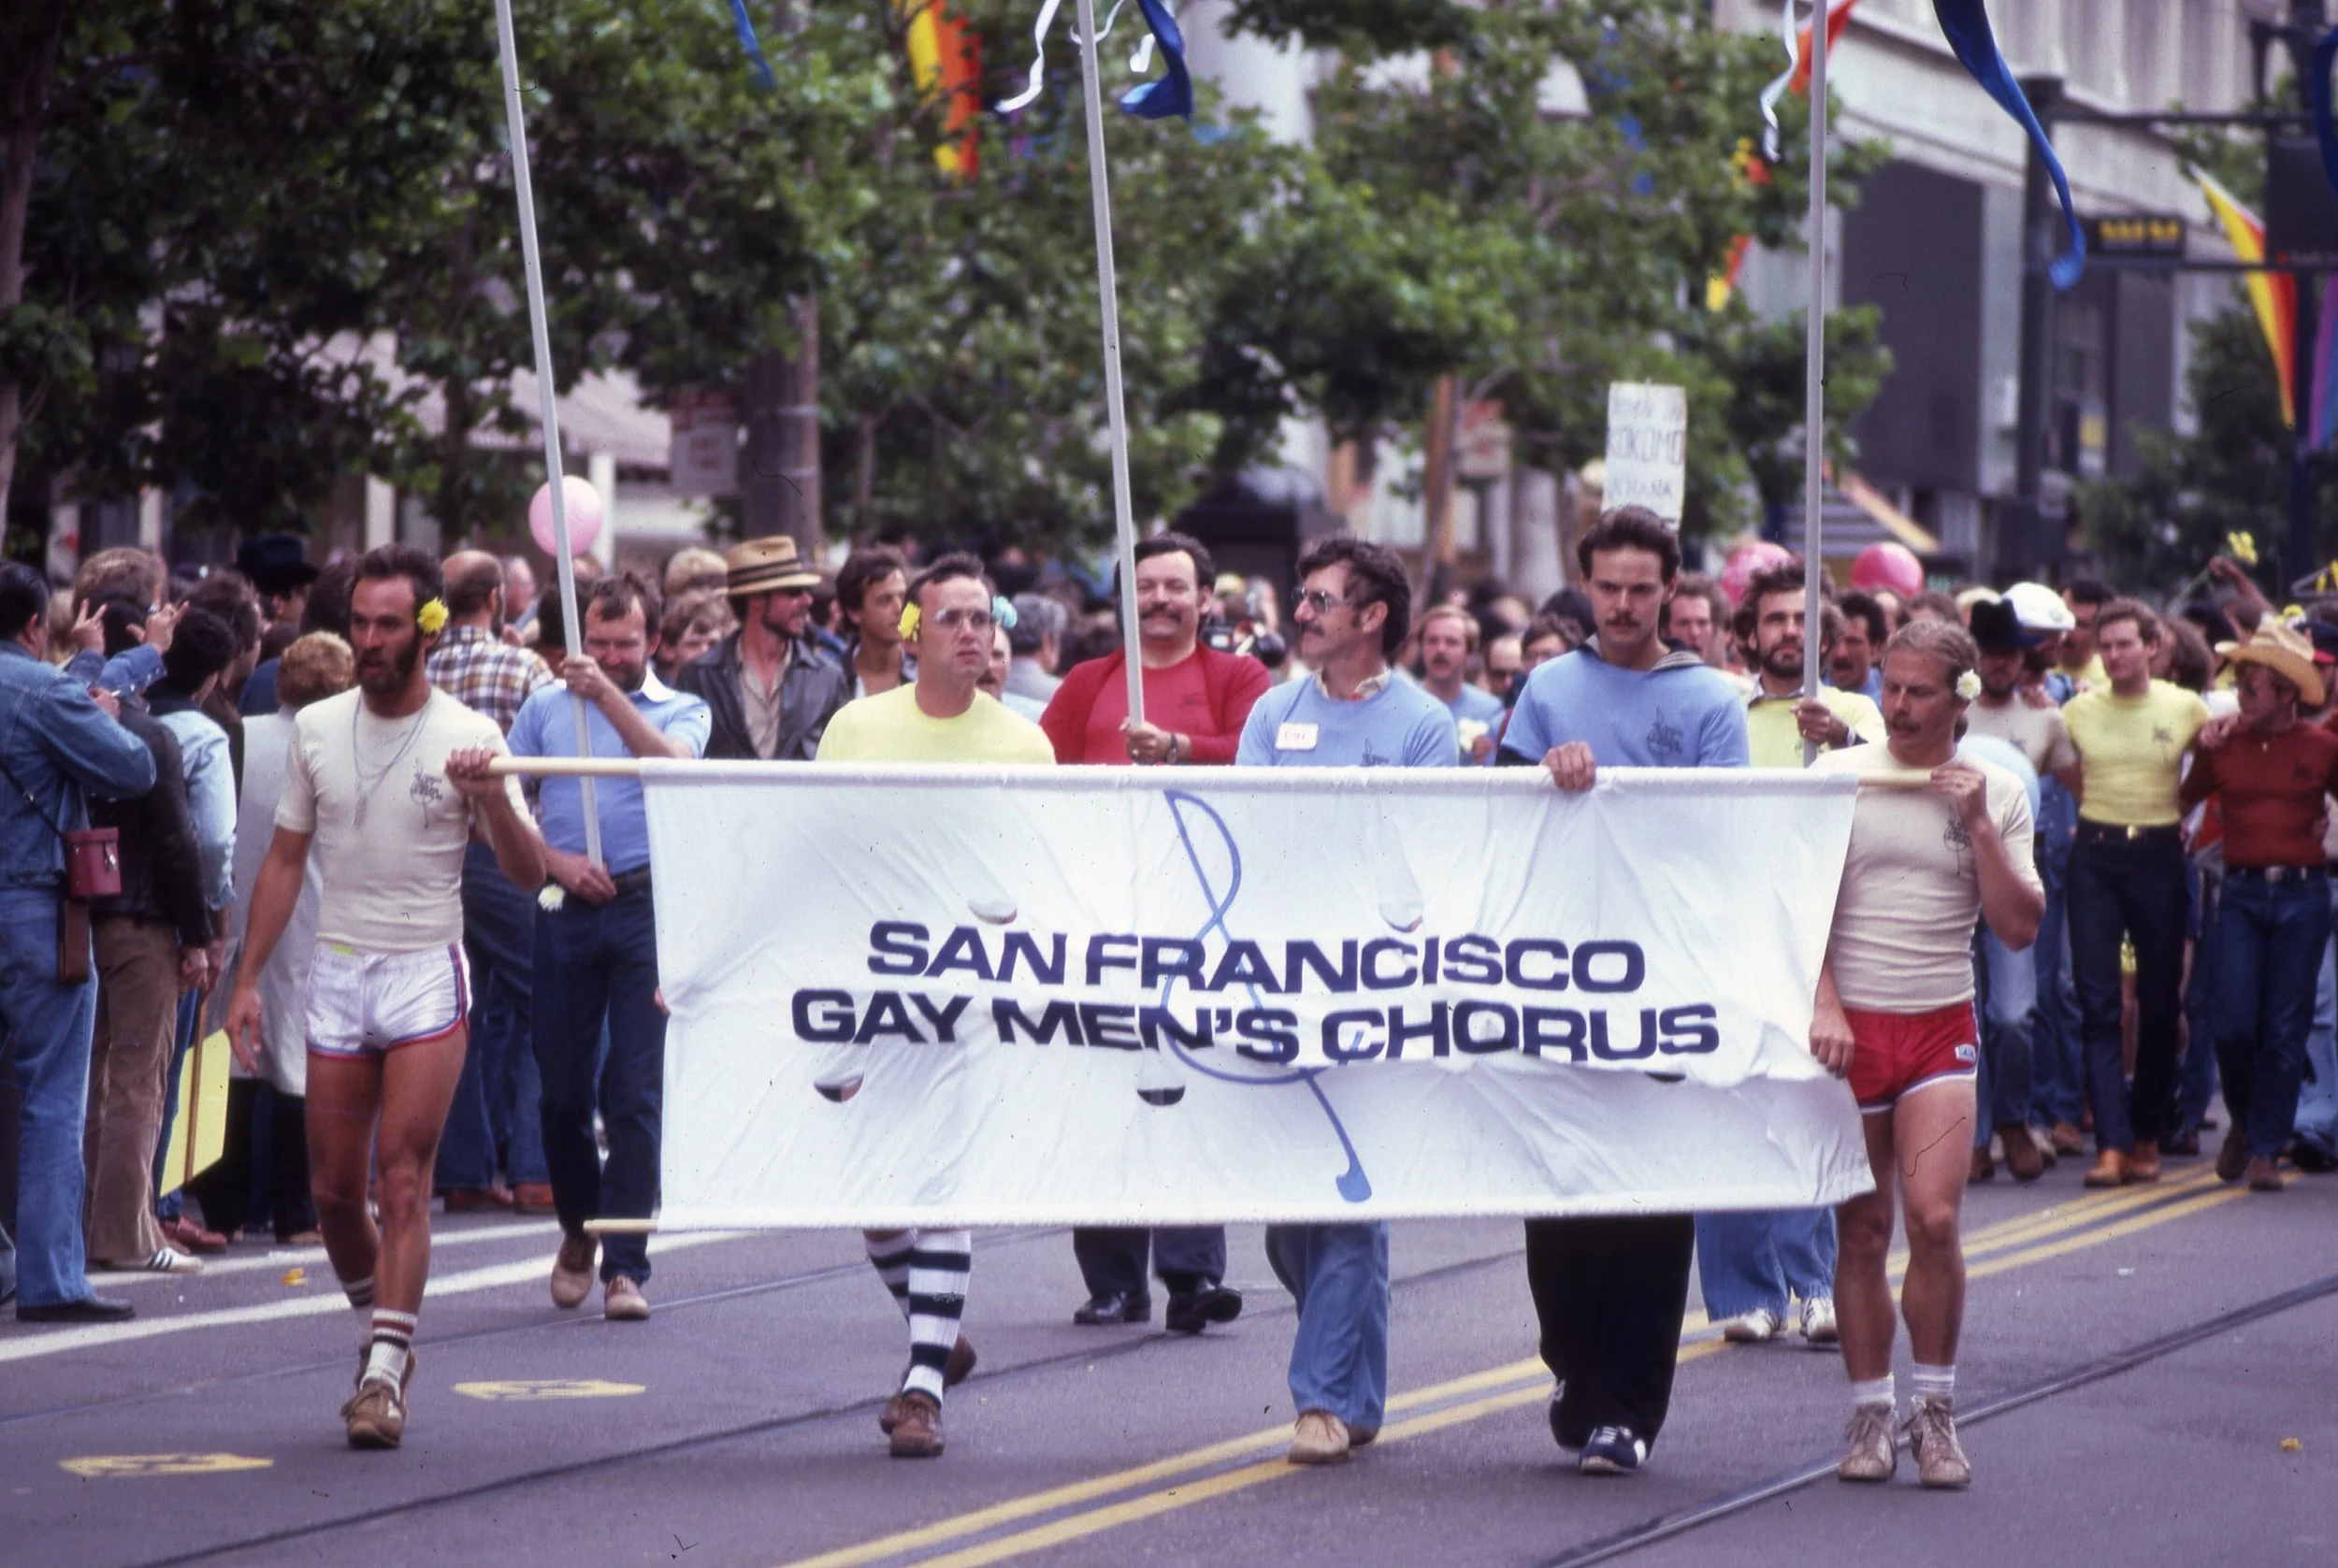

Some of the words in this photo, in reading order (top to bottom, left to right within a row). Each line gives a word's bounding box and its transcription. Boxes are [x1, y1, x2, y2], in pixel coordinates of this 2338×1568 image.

[867, 919, 1068, 986] SAN
[1085, 932, 1646, 994] FRANCISCO
[791, 987, 974, 1044] GAY
[991, 996, 1301, 1064] MEN'S
[1321, 999, 1720, 1063] CHORUS
